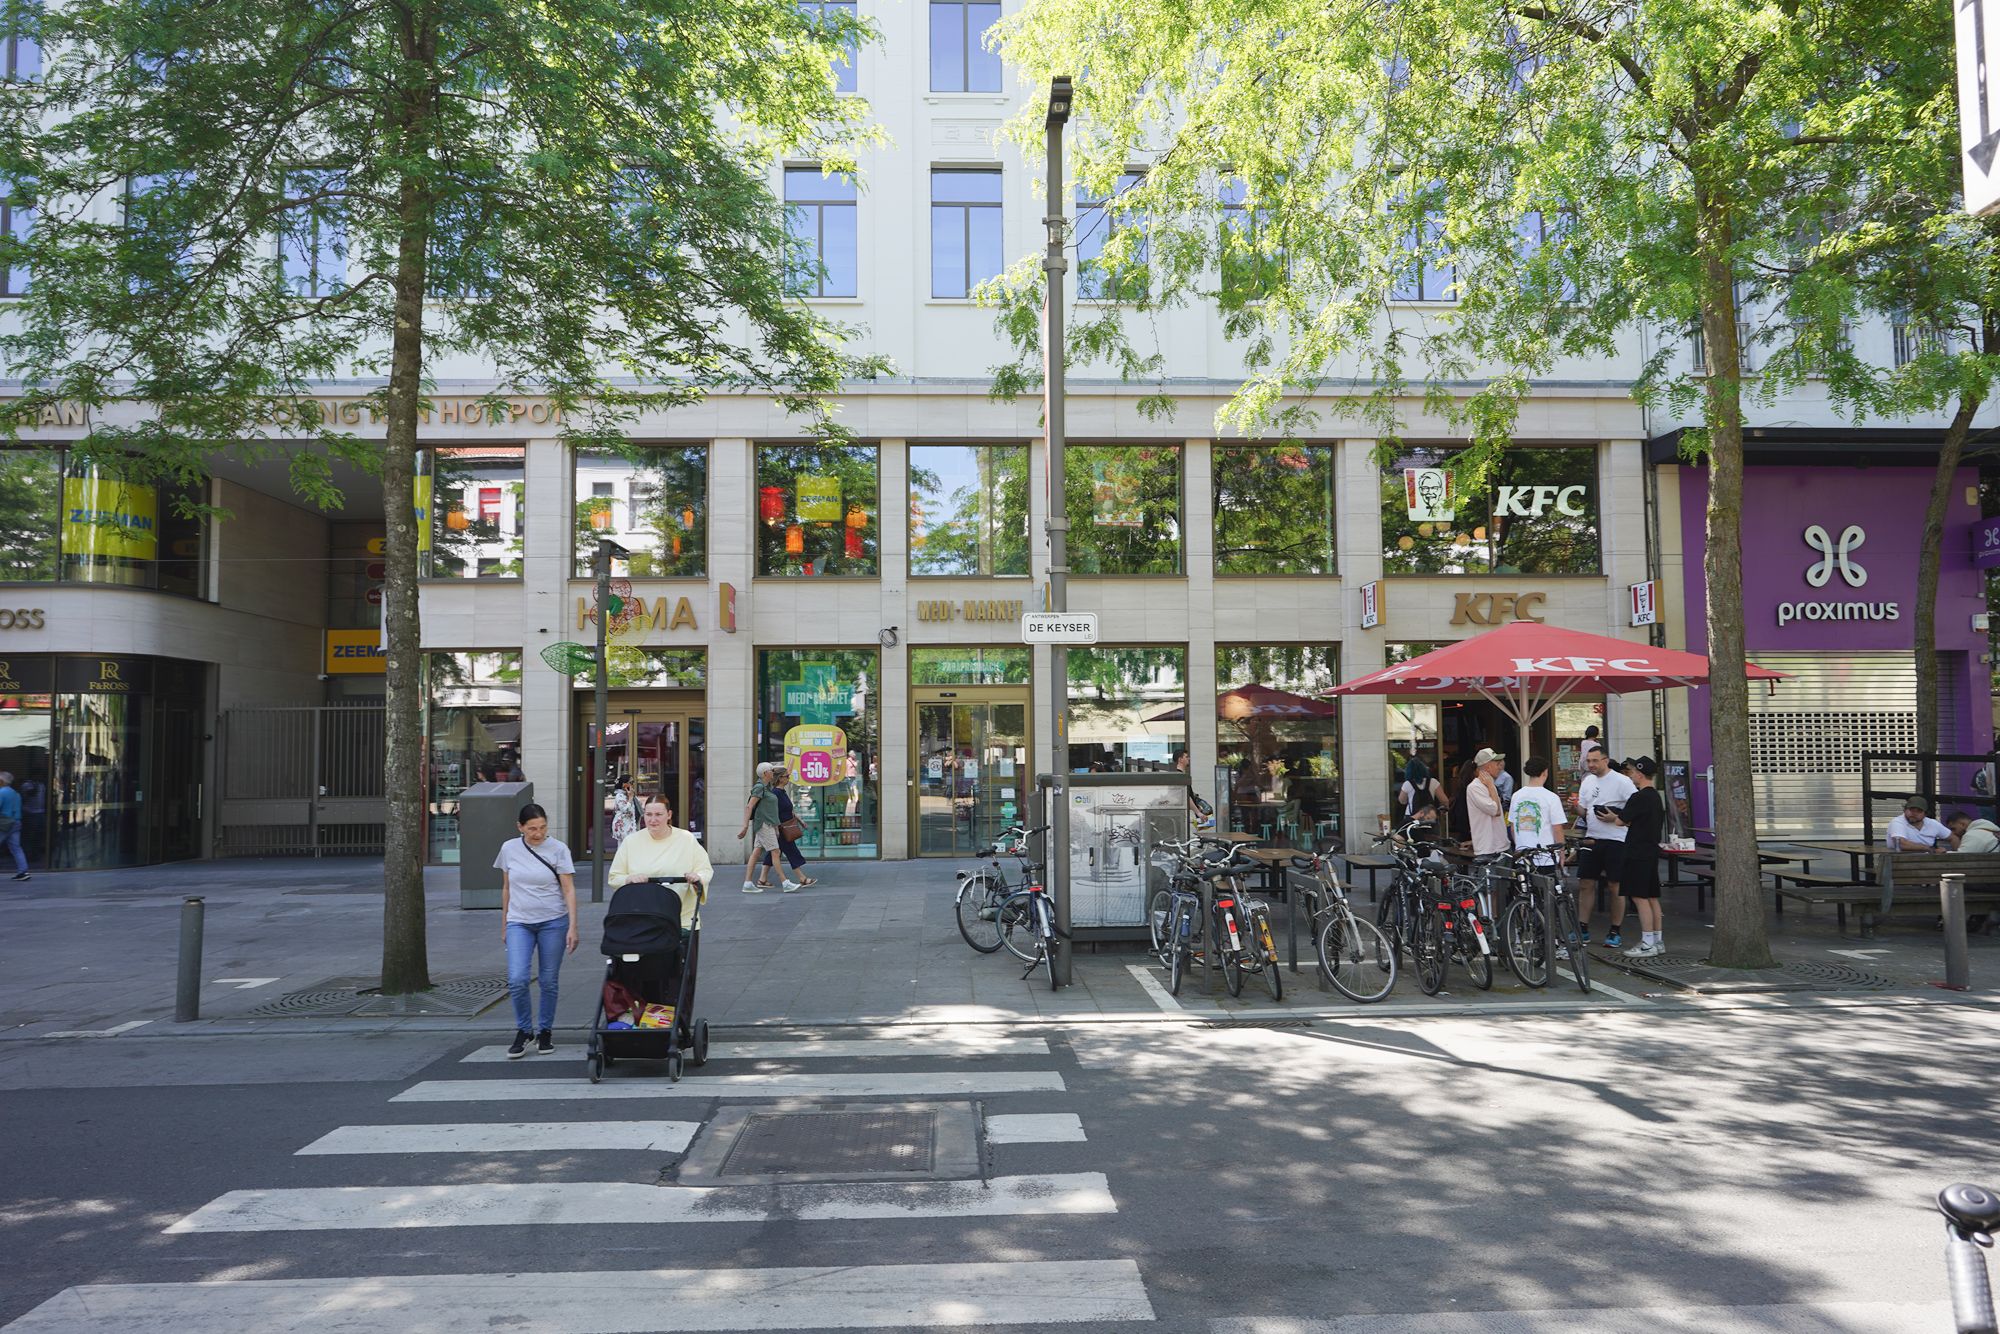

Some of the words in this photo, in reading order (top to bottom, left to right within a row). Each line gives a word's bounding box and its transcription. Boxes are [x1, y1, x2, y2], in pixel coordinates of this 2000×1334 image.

[1493, 485, 1586, 516] KFC
[576, 597, 698, 629] HMA
[1449, 592, 1546, 625] KFC
[1778, 602, 1899, 626] proximus
[1637, 612, 1651, 623] KFC
[1029, 623, 1044, 632] DE
[1046, 623, 1091, 632] KEYSER
[333, 645, 387, 657] ZEEM
[1510, 656, 1659, 672] KFC
[89, 682, 129, 690] F&ROSS
[802, 762, 829, 779] -50%
